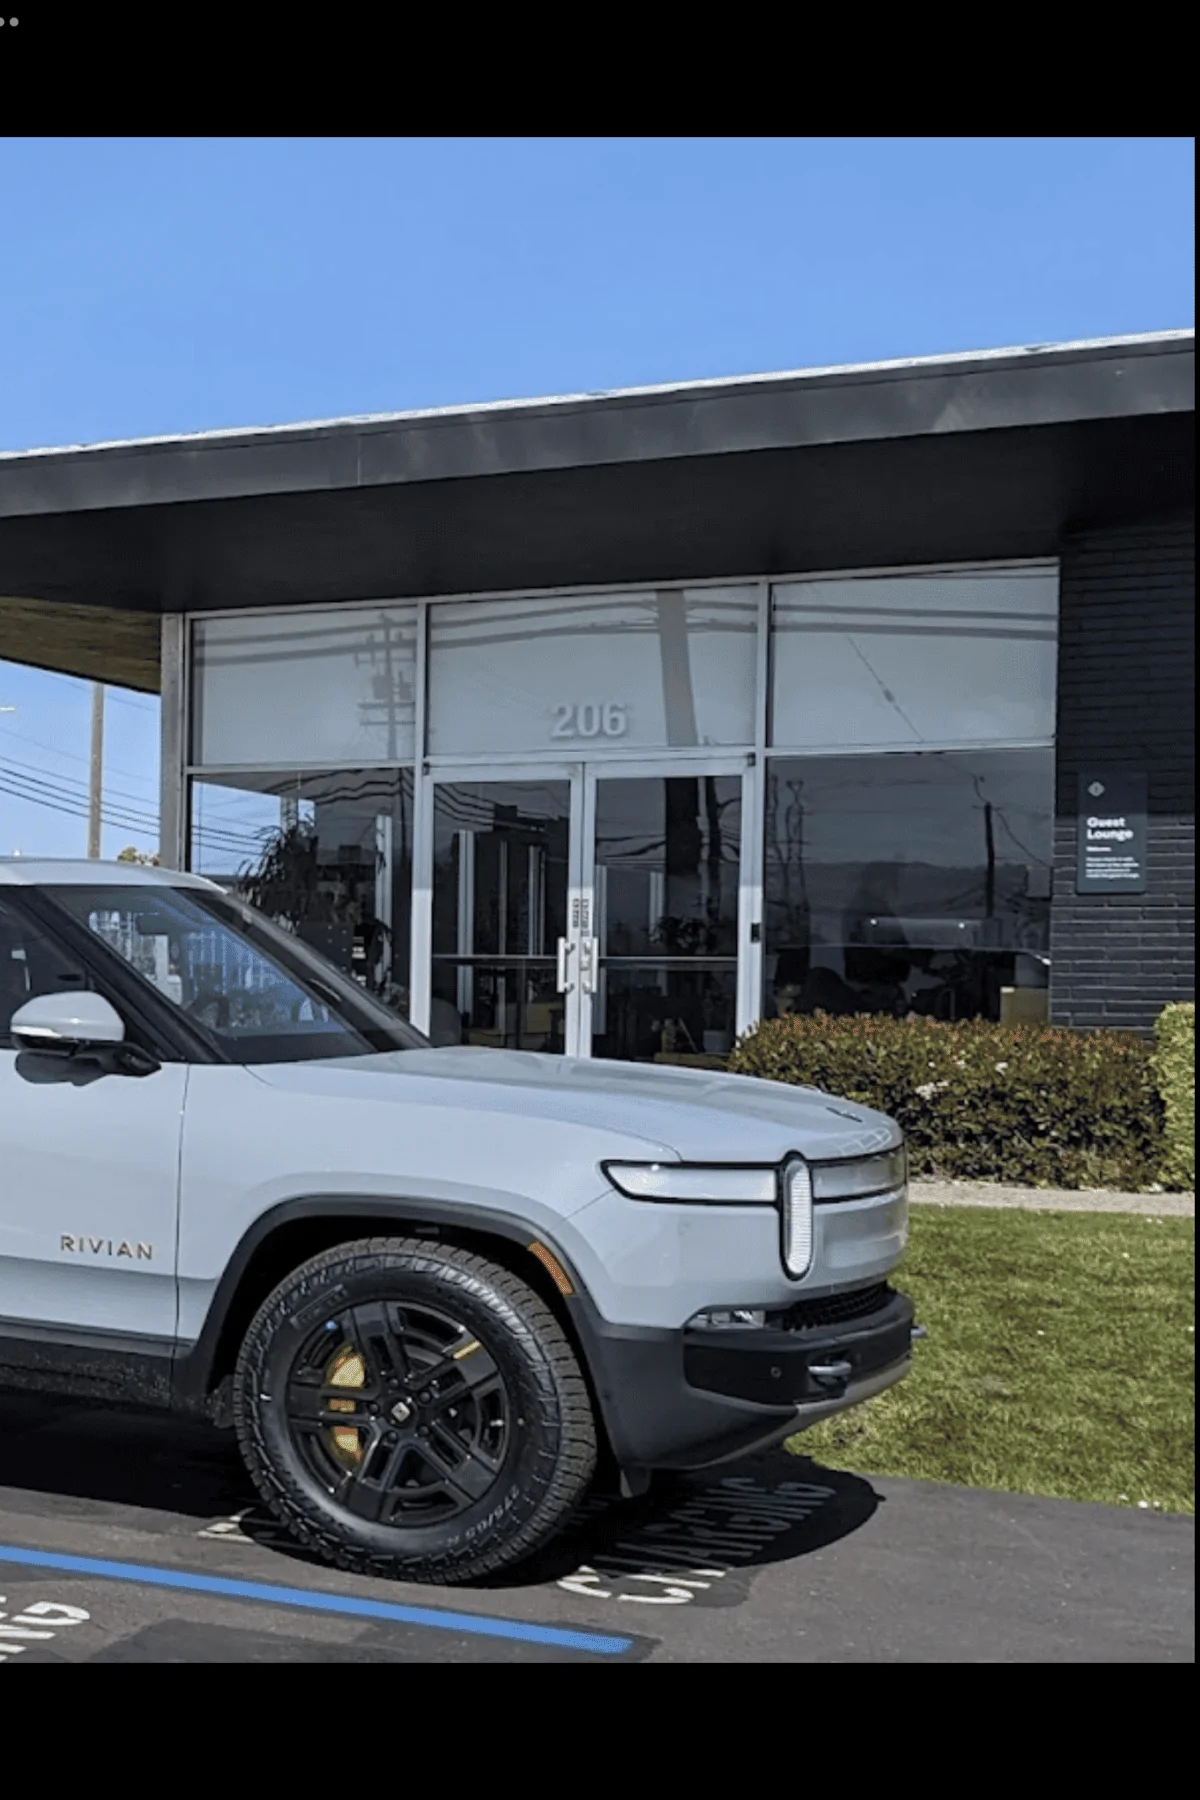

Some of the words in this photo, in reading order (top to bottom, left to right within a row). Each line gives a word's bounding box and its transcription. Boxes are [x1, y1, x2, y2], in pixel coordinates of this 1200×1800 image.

[550, 703, 627, 738] 206
[1086, 816, 1126, 828] Guest
[1087, 829, 1134, 841] Lounge
[60, 1234, 153, 1260] RIVIAN
